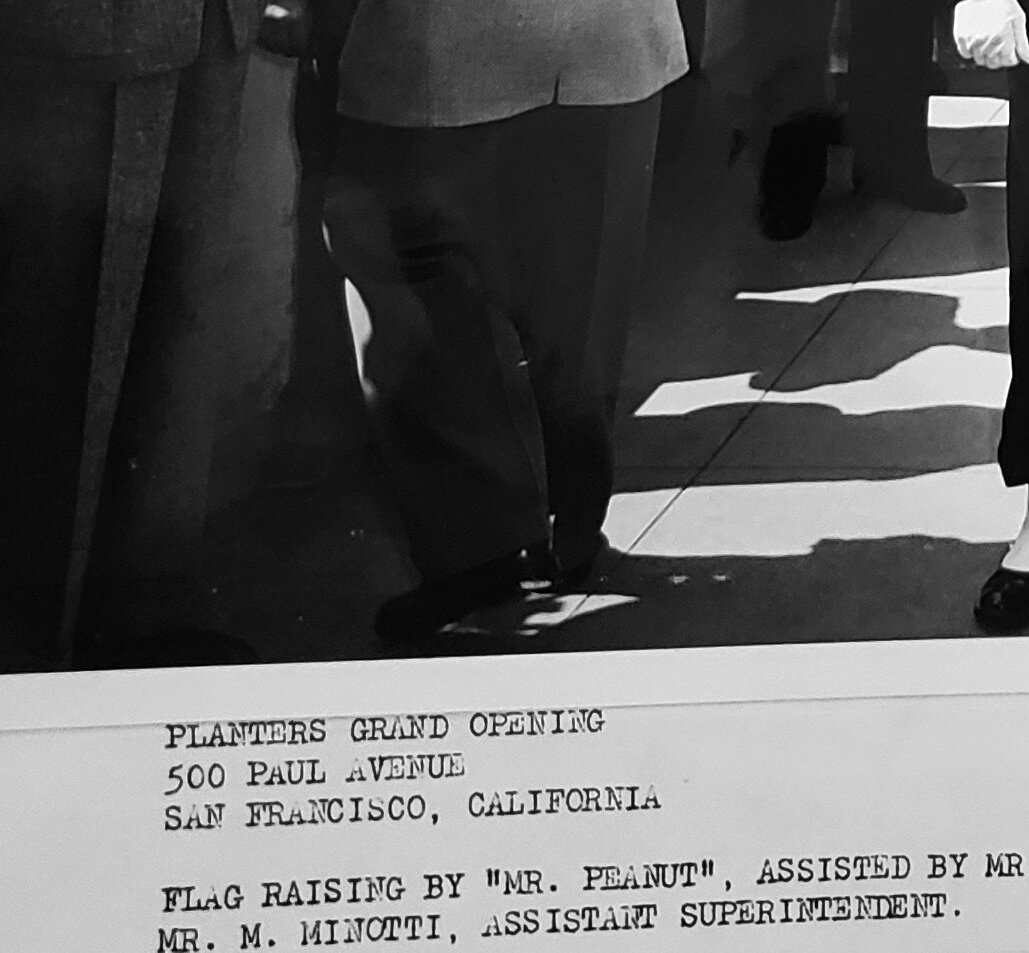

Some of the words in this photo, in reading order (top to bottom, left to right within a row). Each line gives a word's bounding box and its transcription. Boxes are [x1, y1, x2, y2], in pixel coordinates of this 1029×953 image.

[164, 718, 326, 749] PLANTERS
[351, 714, 449, 742] GRAND
[470, 708, 605, 737] OPENING
[164, 763, 225, 796] 500
[246, 759, 326, 786] PAUL
[345, 753, 465, 783] AVENUE
[165, 803, 226, 831] SAN
[245, 795, 438, 827] FRANCISCO,
[469, 785, 661, 818] CALIFORNIA
[161, 884, 244, 913] FLAG
[261, 876, 406, 908] RAISING
[423, 873, 465, 900] BY
[486, 868, 557, 895] "MR.
[583, 859, 731, 892] PEANUT",
[756, 855, 910, 885] ASSISTED
[927, 853, 968, 879] BY
[157, 928, 214, 952] MR.
[240, 923, 276, 950] M.
[300, 915, 456, 946] MINOTTI,
[481, 904, 657, 937] ASSISTANT
[680, 893, 960, 928] SUPERINTENDENT.
